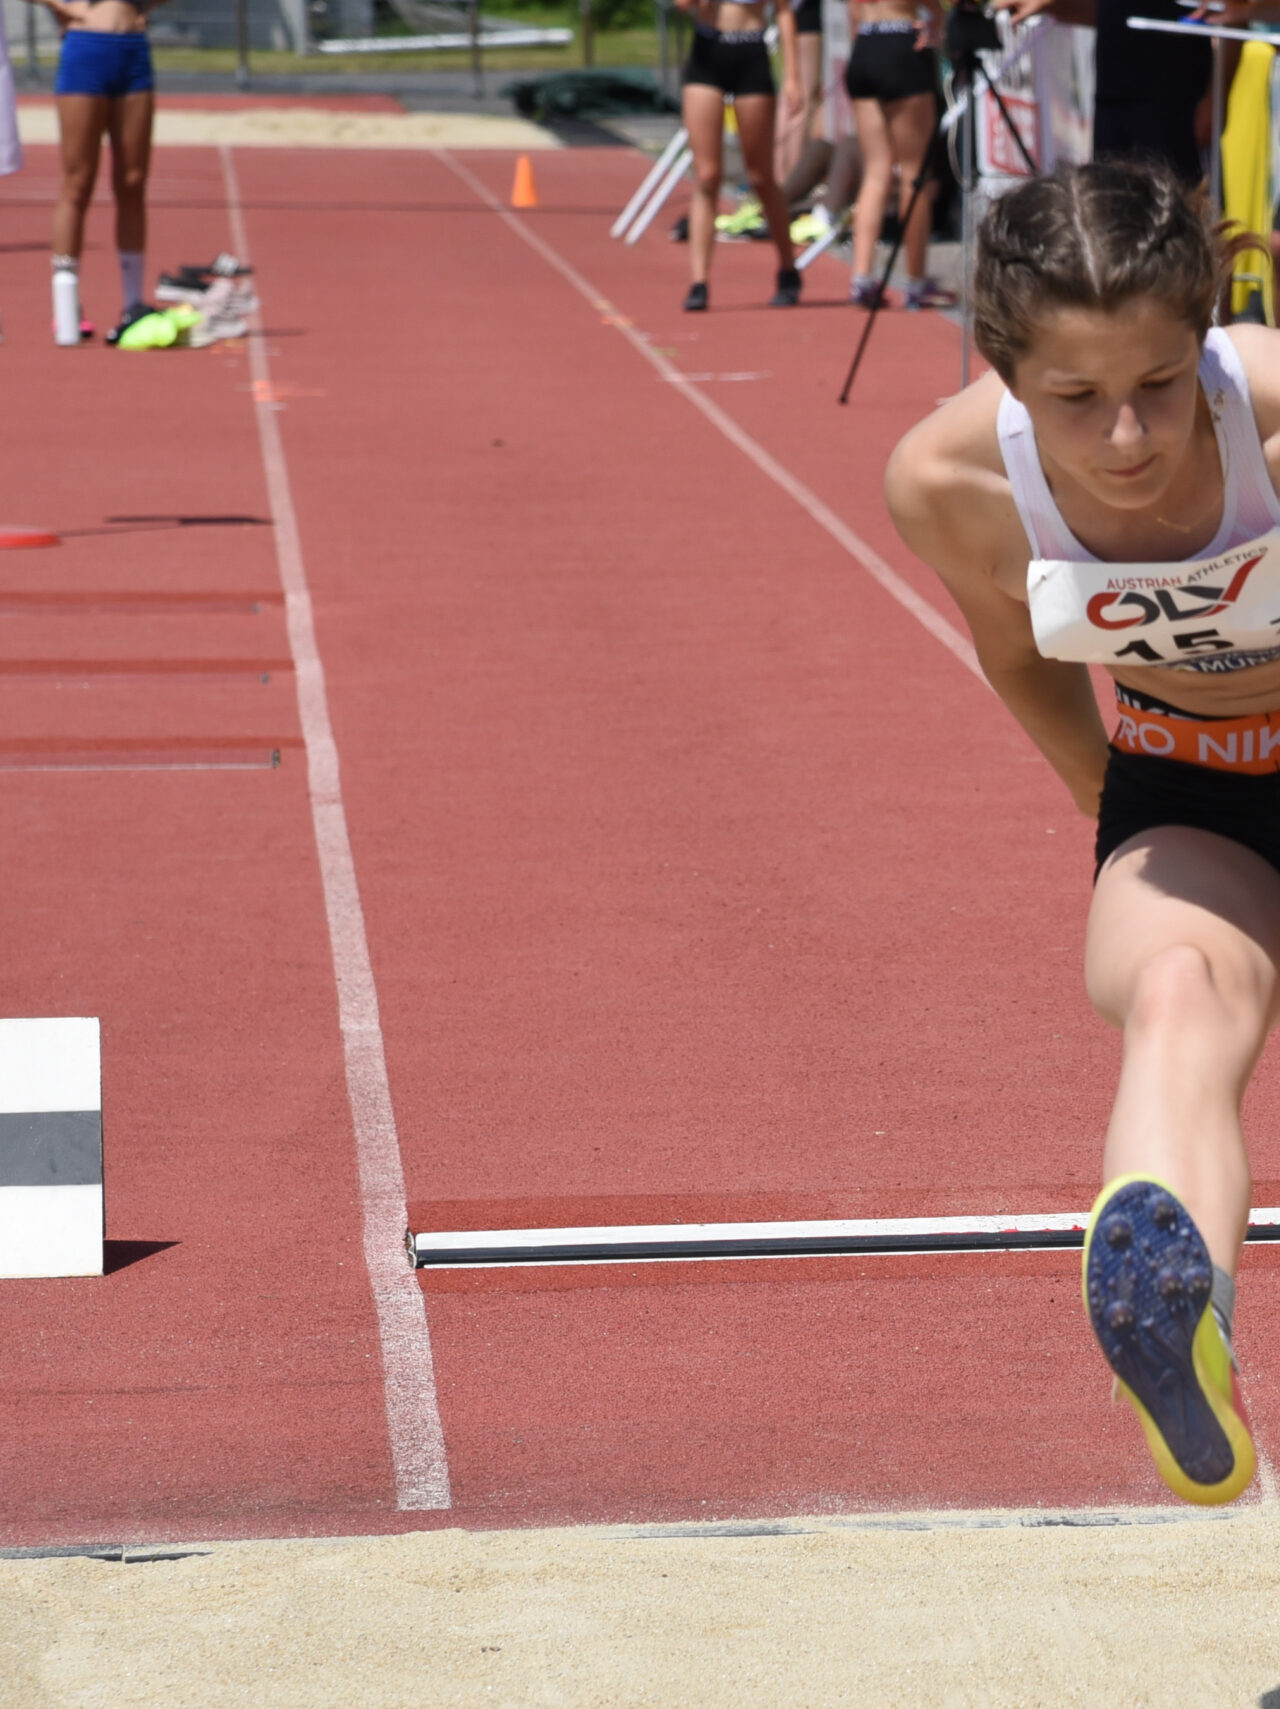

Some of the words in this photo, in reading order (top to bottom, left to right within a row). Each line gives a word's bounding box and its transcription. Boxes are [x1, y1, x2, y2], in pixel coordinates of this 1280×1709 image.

[1106, 576, 1182, 590] AUSTRIAN
[1187, 546, 1268, 584] ATHLETICS
[1114, 629, 1234, 662] 15
[1118, 714, 1175, 756] RO
